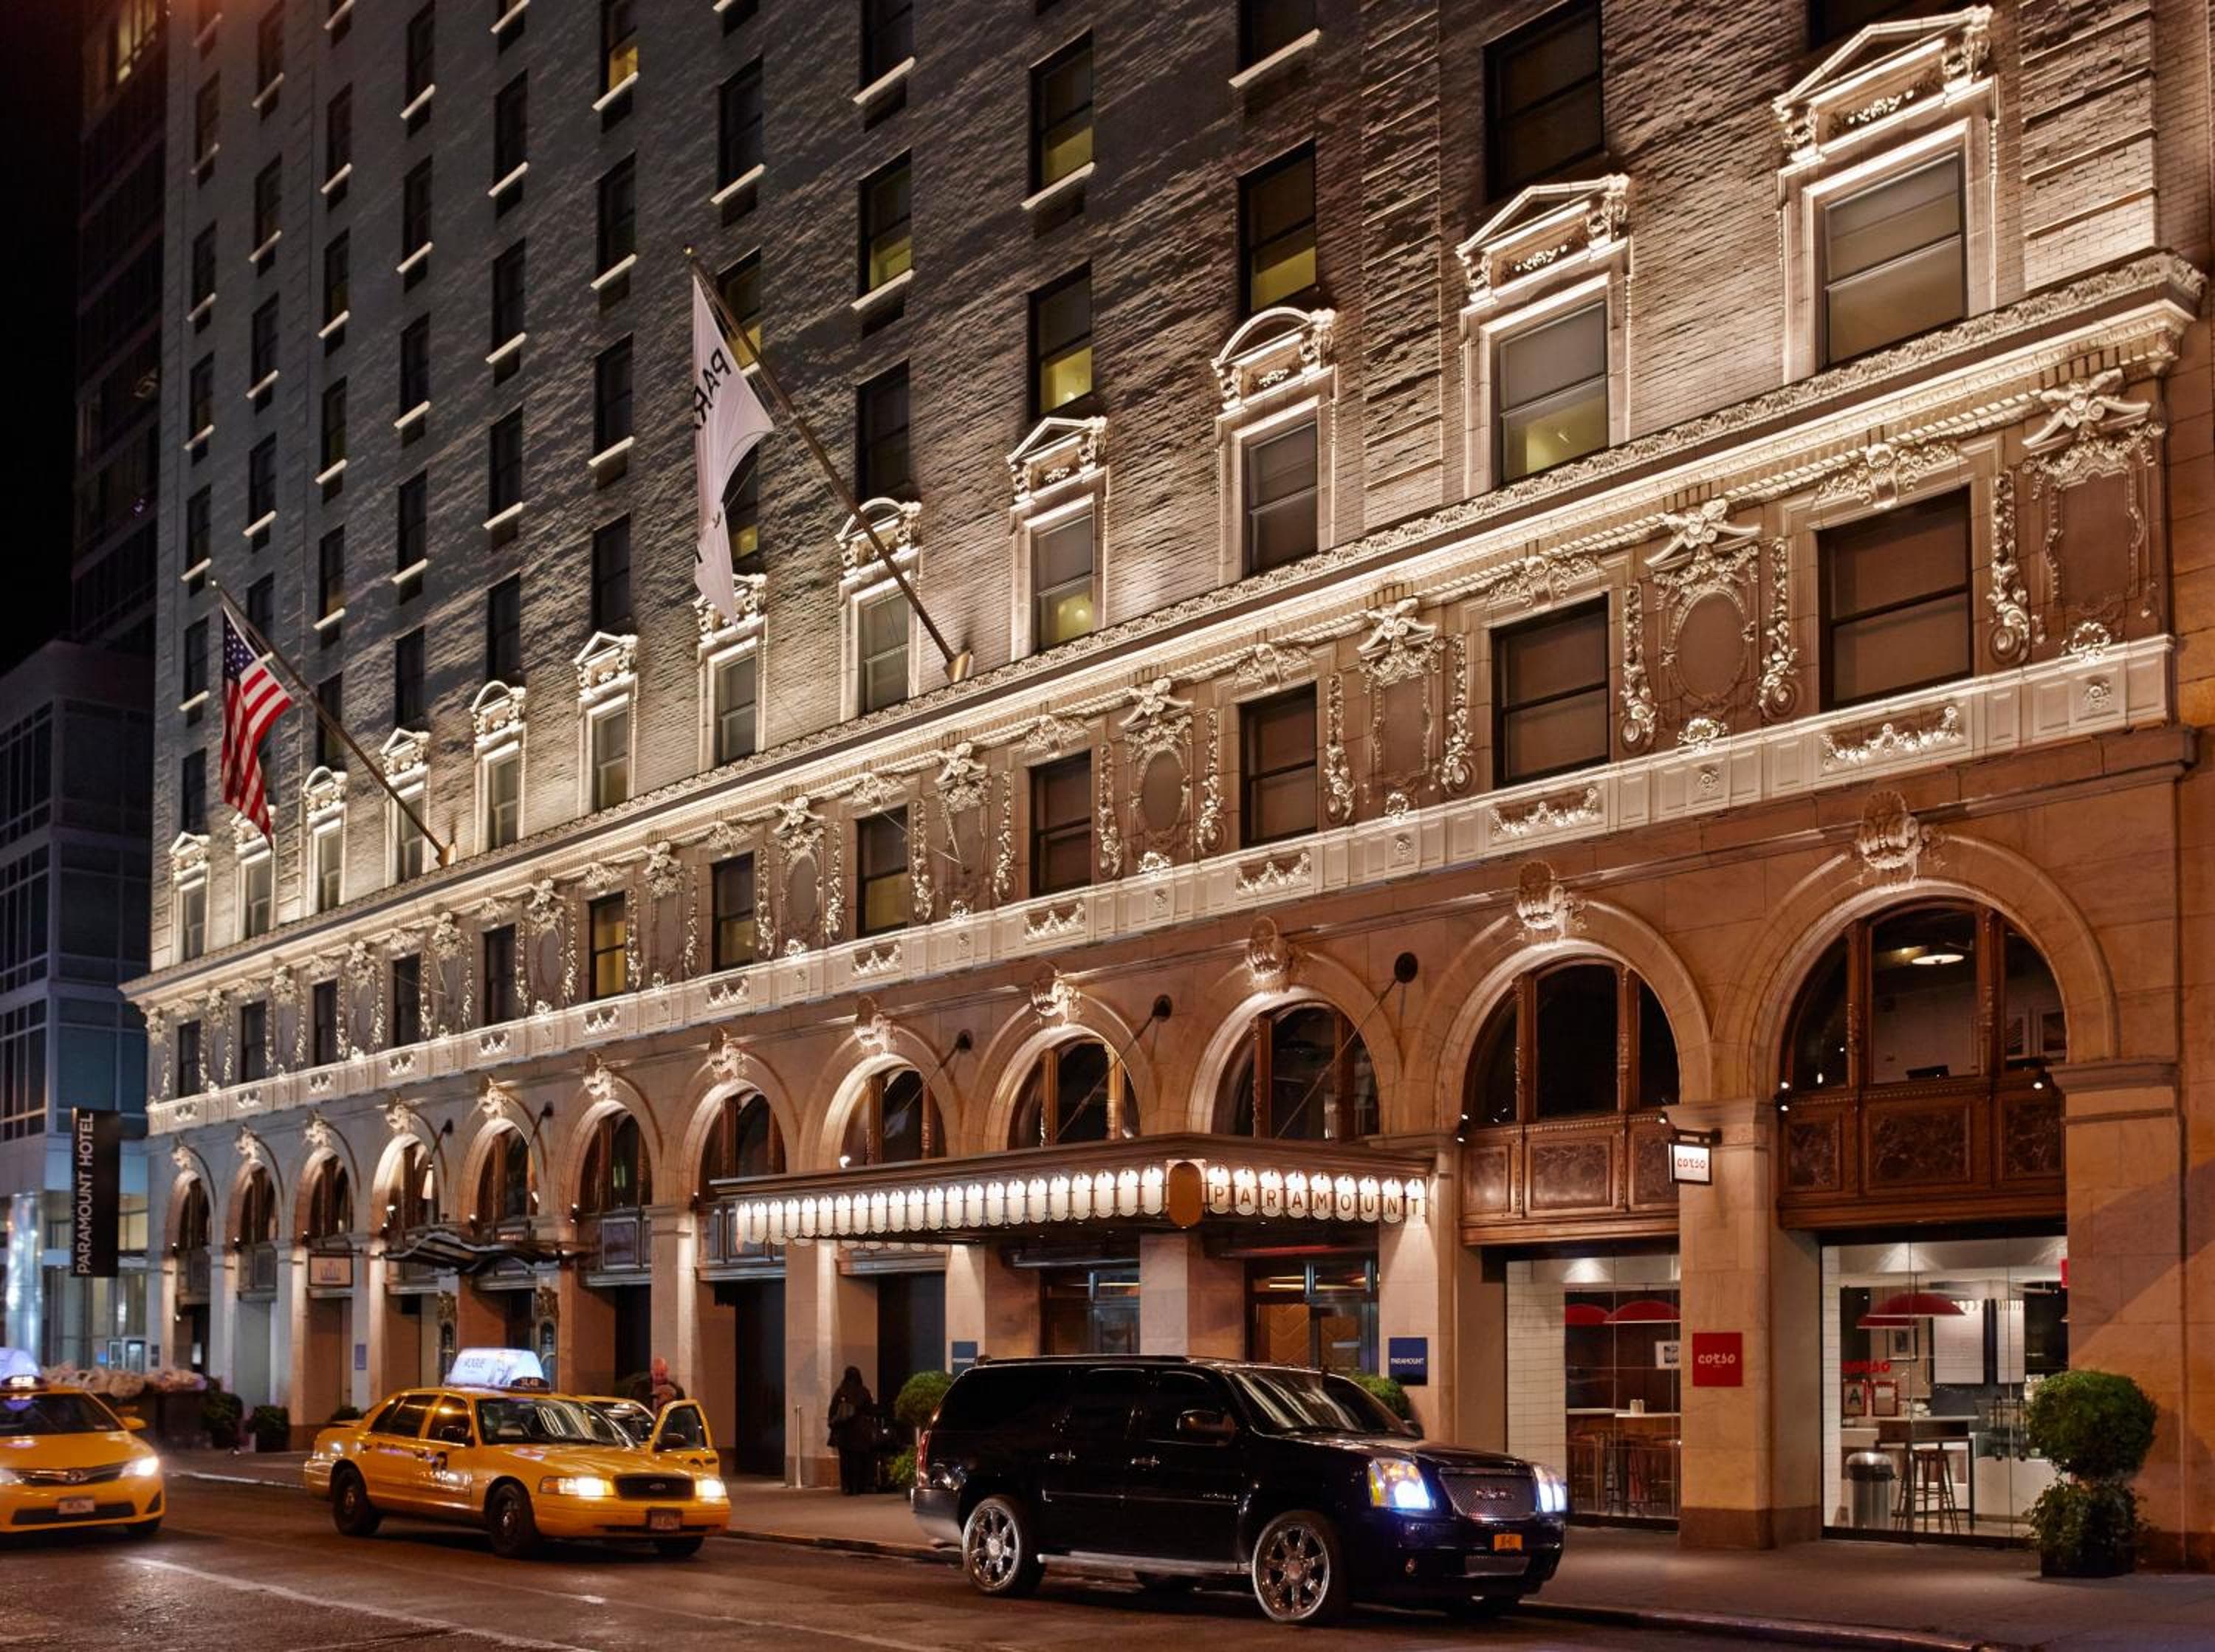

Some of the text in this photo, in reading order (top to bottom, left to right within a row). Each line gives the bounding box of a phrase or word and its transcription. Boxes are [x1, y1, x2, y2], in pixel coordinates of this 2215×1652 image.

[77, 1112, 95, 1275] PARAMOUNT HOTEL
[1213, 1185, 1420, 1216] PARAMOUNT
